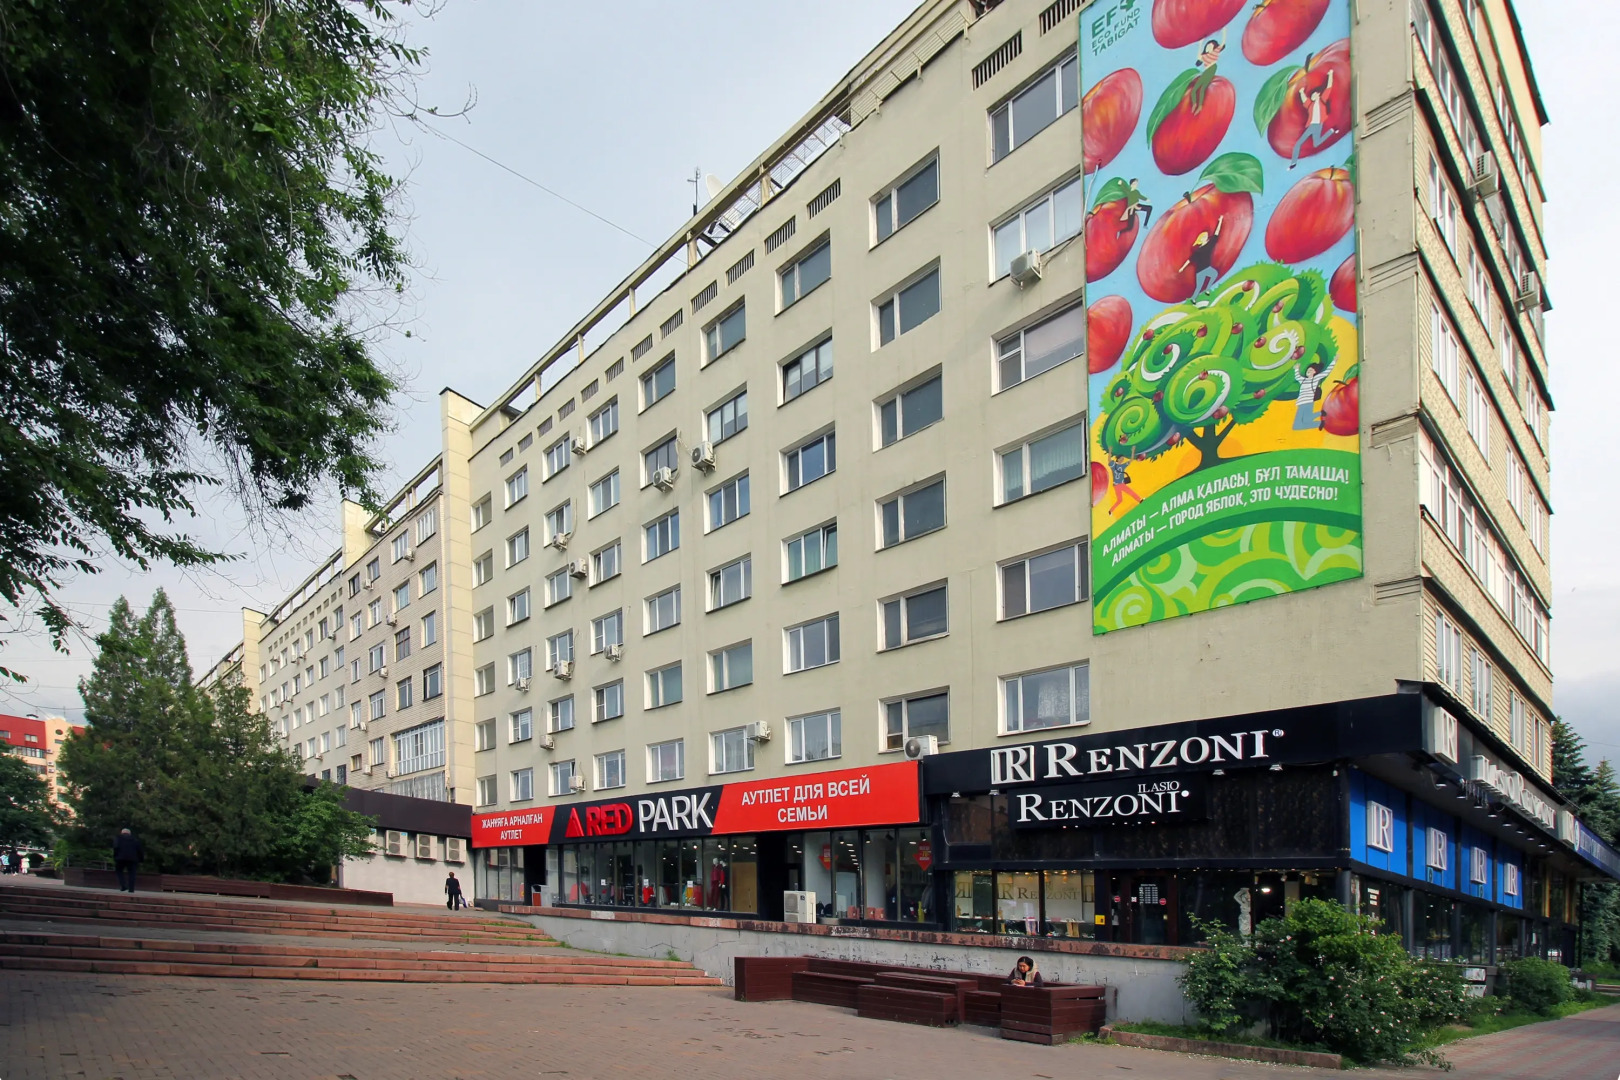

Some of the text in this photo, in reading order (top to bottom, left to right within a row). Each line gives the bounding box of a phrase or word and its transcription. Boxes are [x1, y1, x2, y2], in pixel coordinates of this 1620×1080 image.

[1092, 8, 1140, 49] ECO FUND
[1092, 16, 1140, 56] TABIGAT
[1103, 514, 1147, 556] АЛМАТЫ
[1161, 489, 1194, 515] АЛМА
[1197, 471, 1251, 499] ҚАЛАСЫ,
[1255, 466, 1281, 483] БҰЛ
[1285, 465, 1349, 485] ТАМАША!
[1112, 527, 1154, 567] АЛМАТЫ
[1169, 503, 1204, 529] ГОРОД
[1206, 492, 1248, 515] ЯБЛОК,
[1250, 487, 1271, 504] ЭТО
[1275, 485, 1338, 501] ЧУДЕСНО!
[742, 774, 870, 806] АУТЛЕТ ДЛЯ ВСЕЙ
[586, 792, 714, 836] RED PARK
[777, 805, 828, 823] СЕМЬИ
[500, 829, 522, 840] АУТЛЕТ
